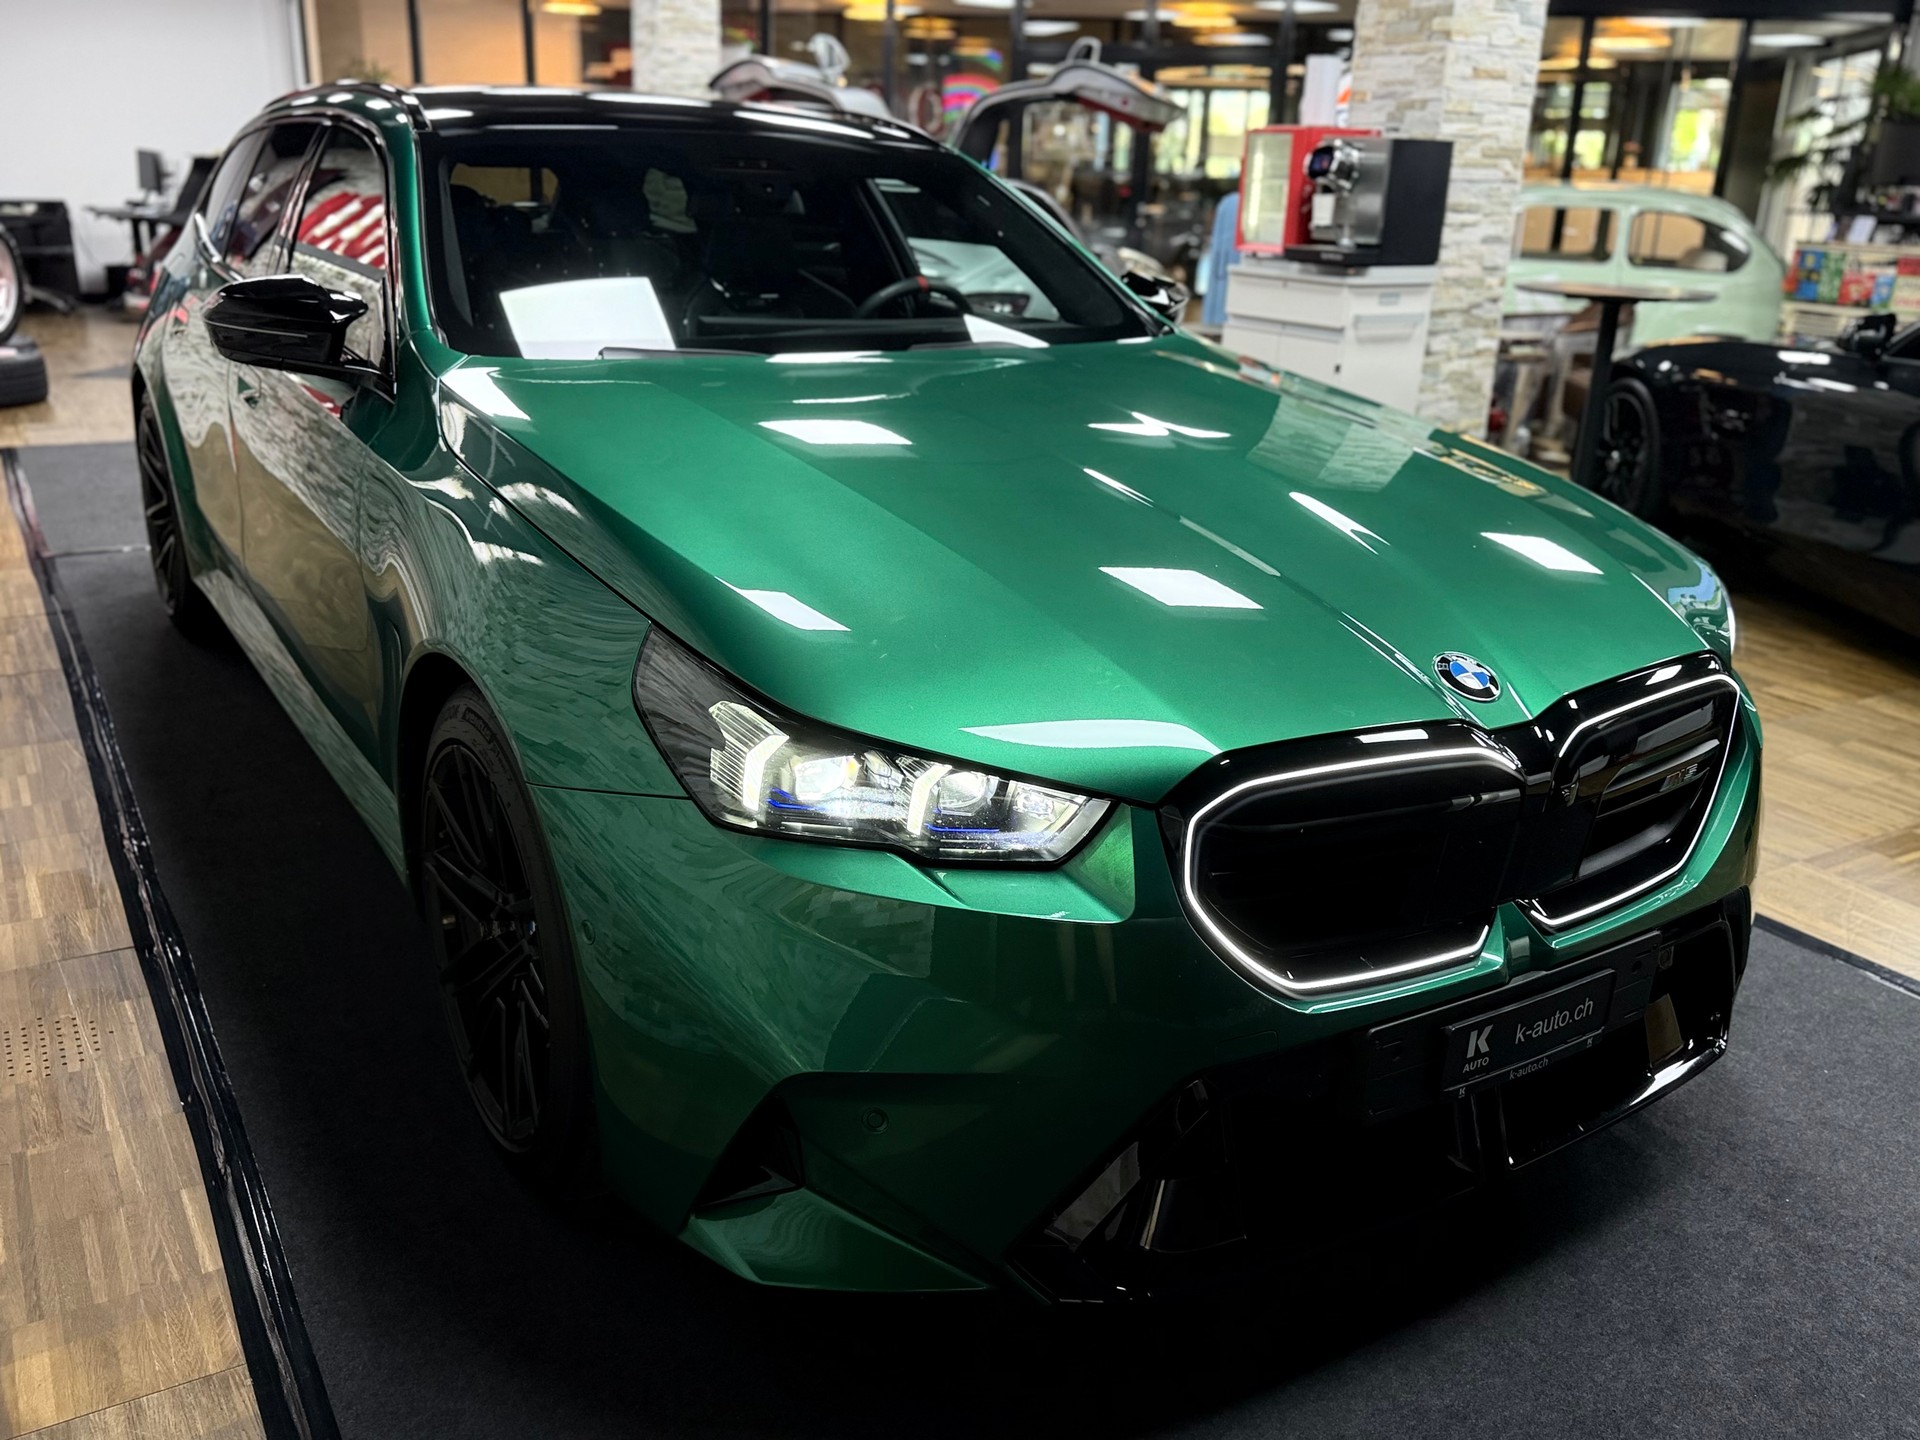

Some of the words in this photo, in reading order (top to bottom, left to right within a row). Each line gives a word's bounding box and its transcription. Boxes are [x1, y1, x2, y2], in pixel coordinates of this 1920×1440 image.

[1515, 997, 1594, 1045] k-auto.ch
[1466, 1024, 1494, 1059] K
[1462, 1056, 1490, 1074] AUTO
[1509, 1057, 1549, 1080] k-auto.ch
